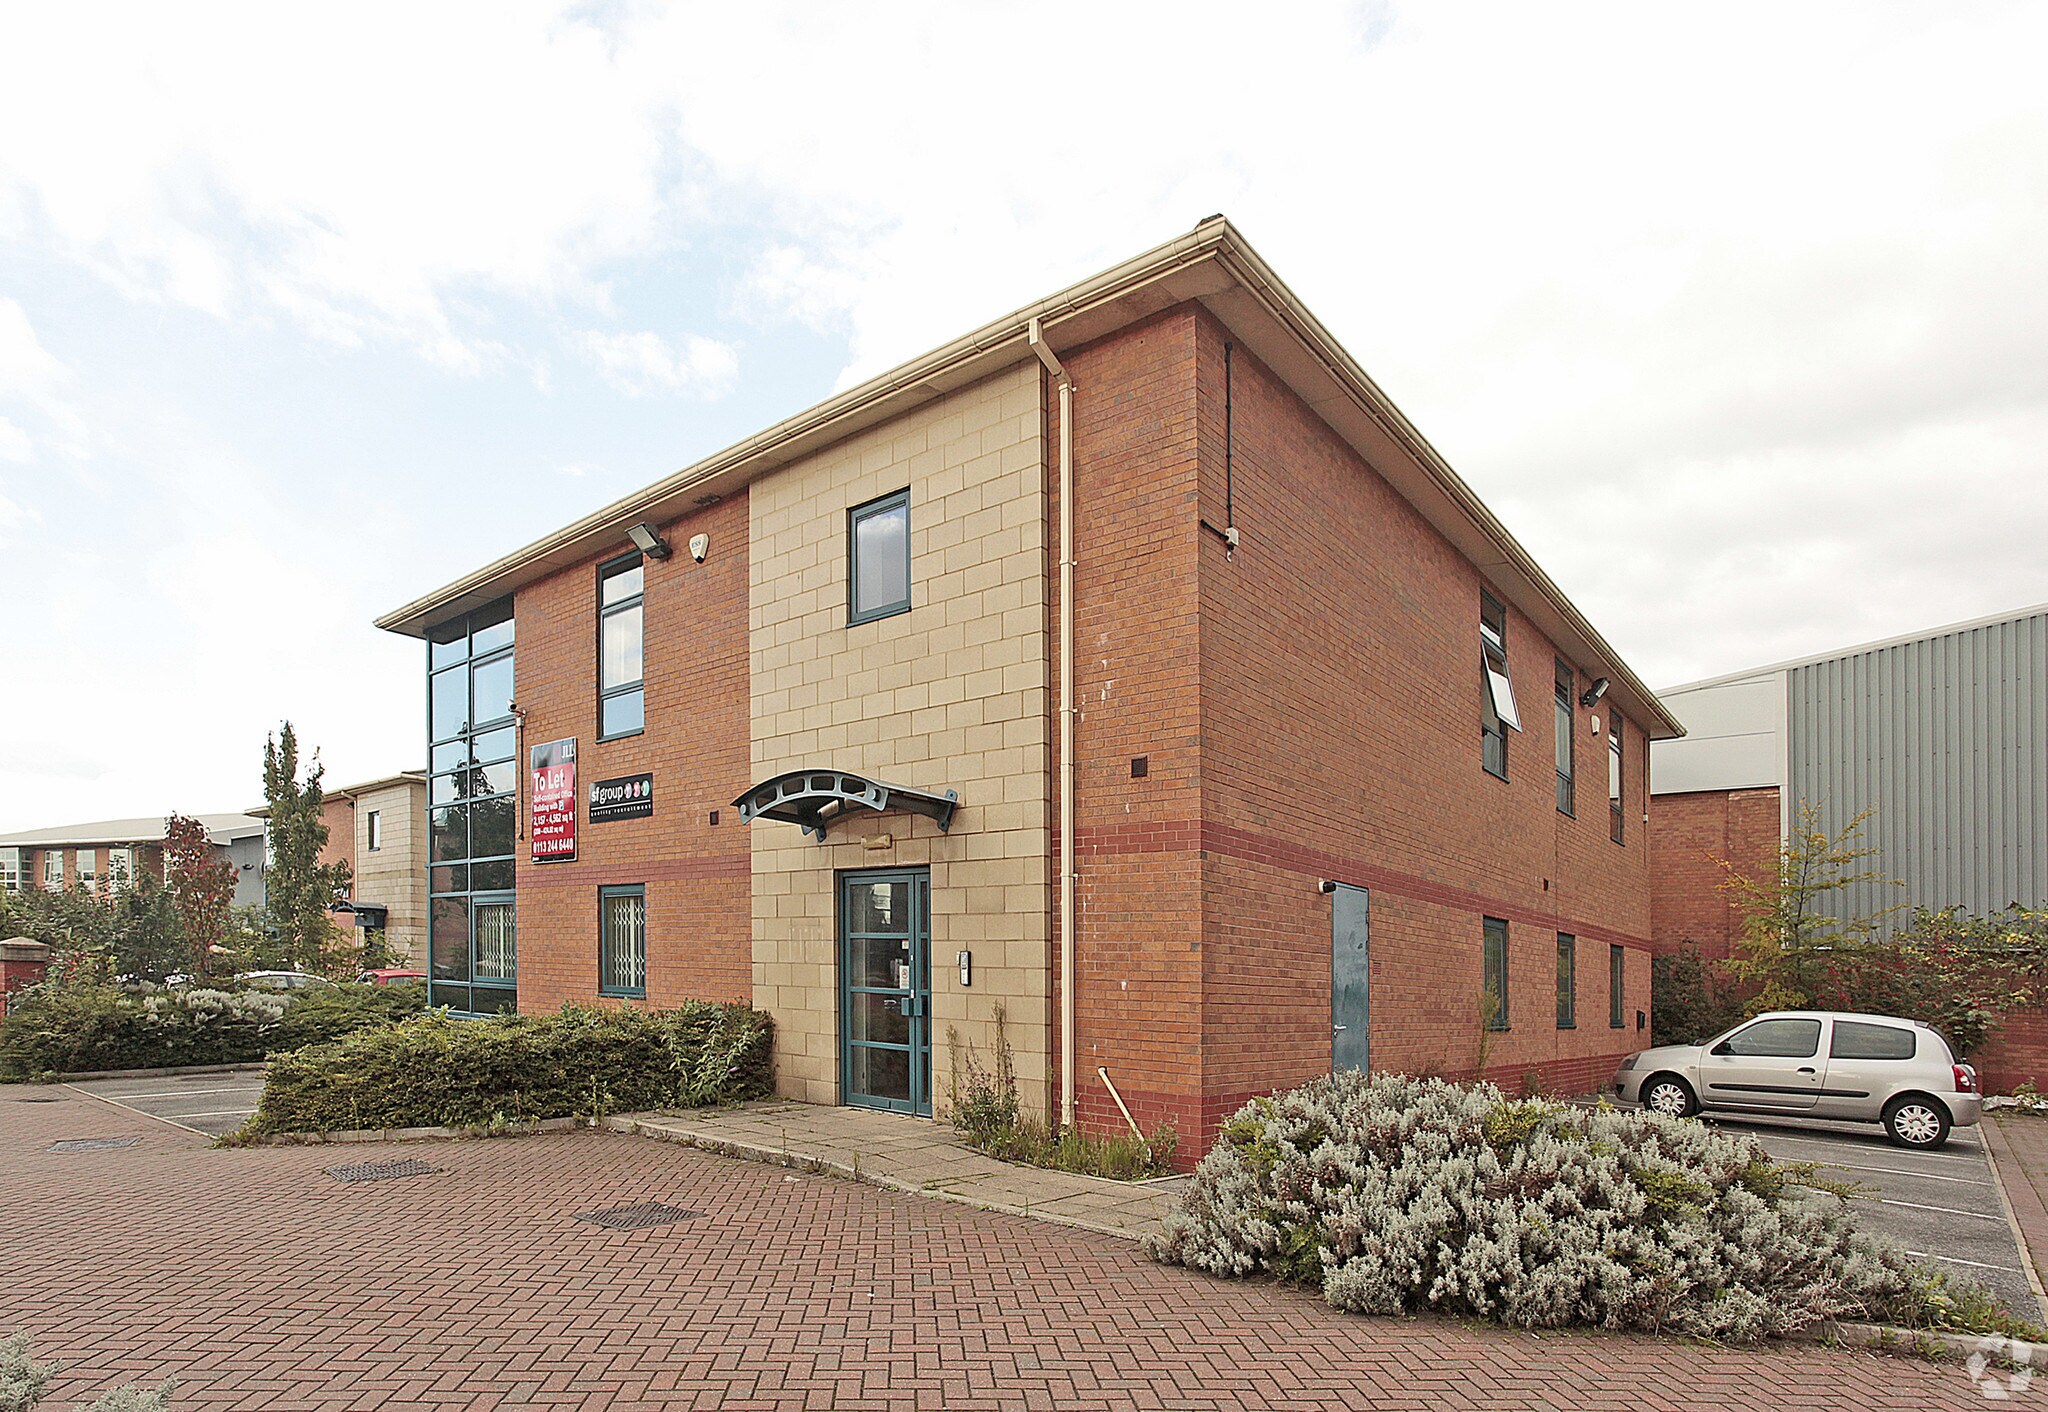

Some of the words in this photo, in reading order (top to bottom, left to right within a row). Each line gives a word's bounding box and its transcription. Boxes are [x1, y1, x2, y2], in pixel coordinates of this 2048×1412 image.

[561, 744, 574, 759] JLL
[533, 772, 546, 792] To
[547, 769, 565, 789] Let
[614, 804, 651, 813] recruitment
[562, 814, 568, 823] sq
[533, 841, 547, 854] 0113
[547, 840, 558, 853] 244
[558, 838, 574, 851] 6440
